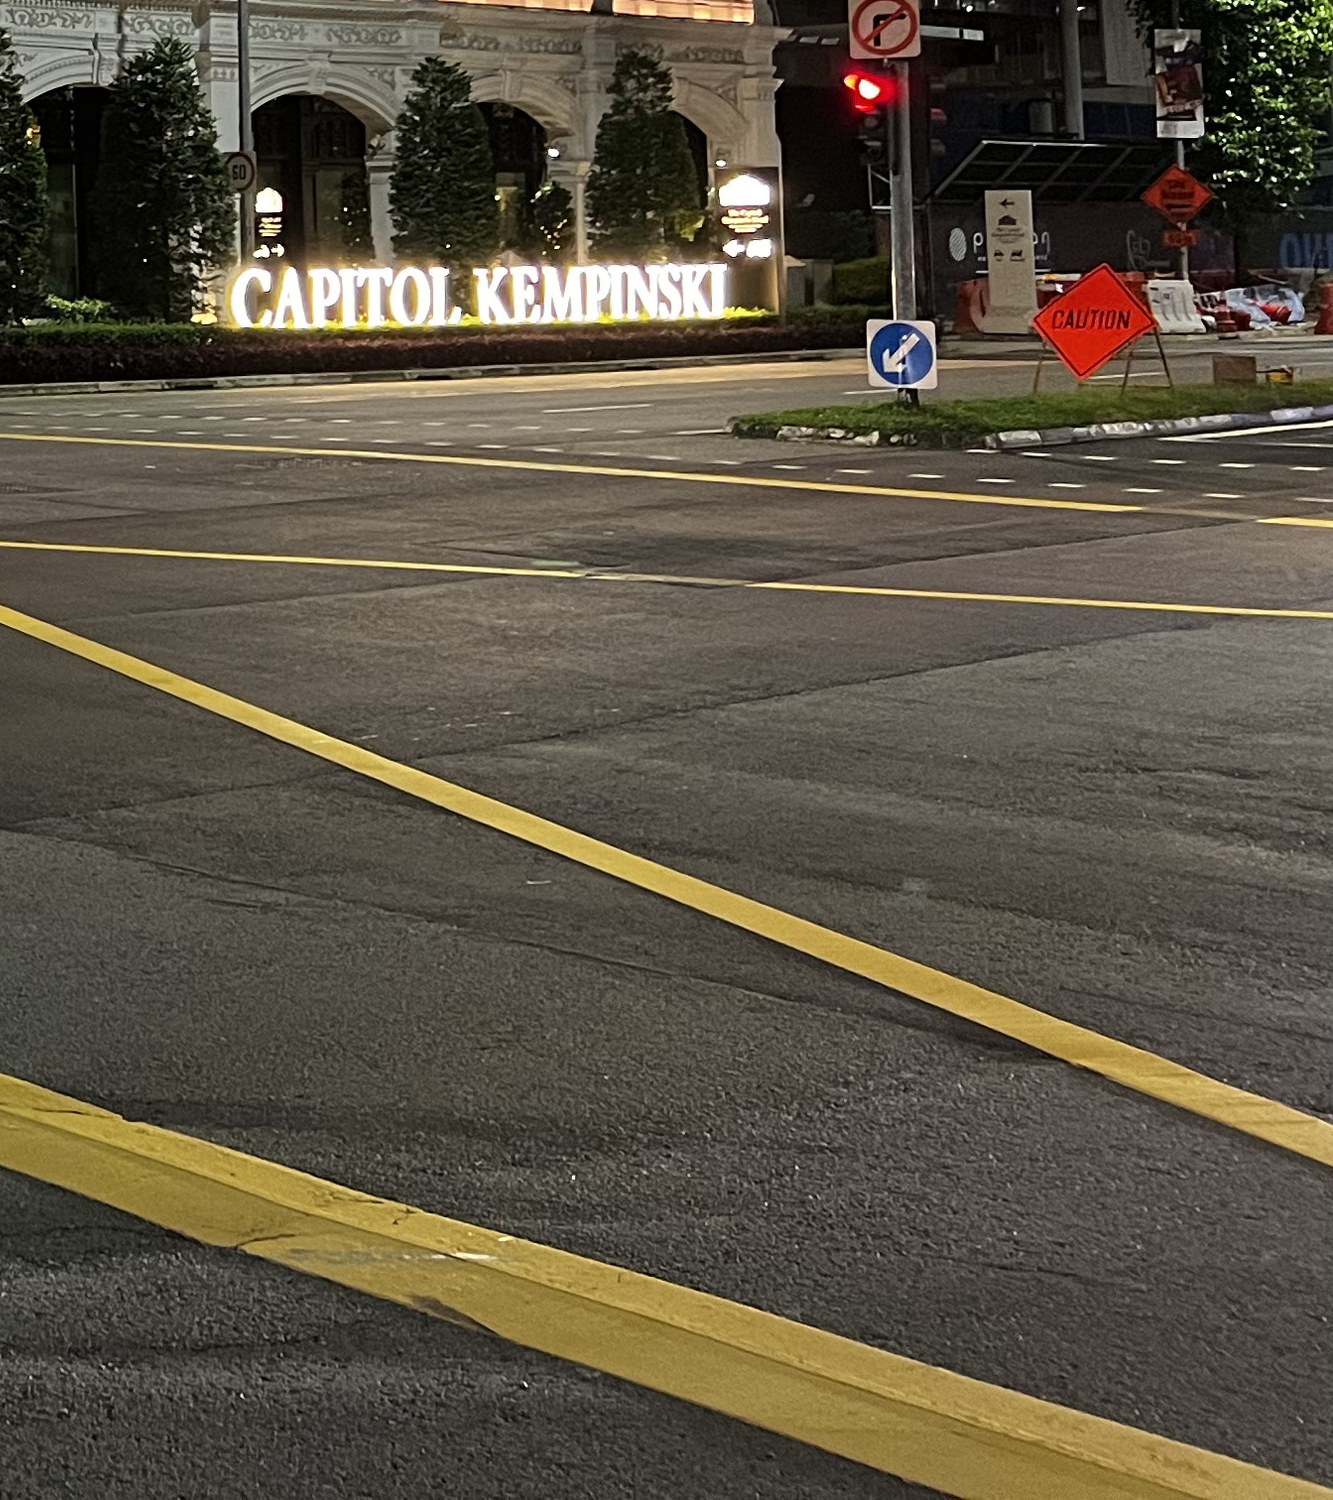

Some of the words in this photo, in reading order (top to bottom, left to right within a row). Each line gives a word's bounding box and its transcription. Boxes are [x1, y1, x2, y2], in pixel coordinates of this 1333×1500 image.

[233, 266, 462, 328] CAPITOL
[472, 263, 728, 325] KEMPINSKI
[1052, 309, 1132, 330] CAUTION
